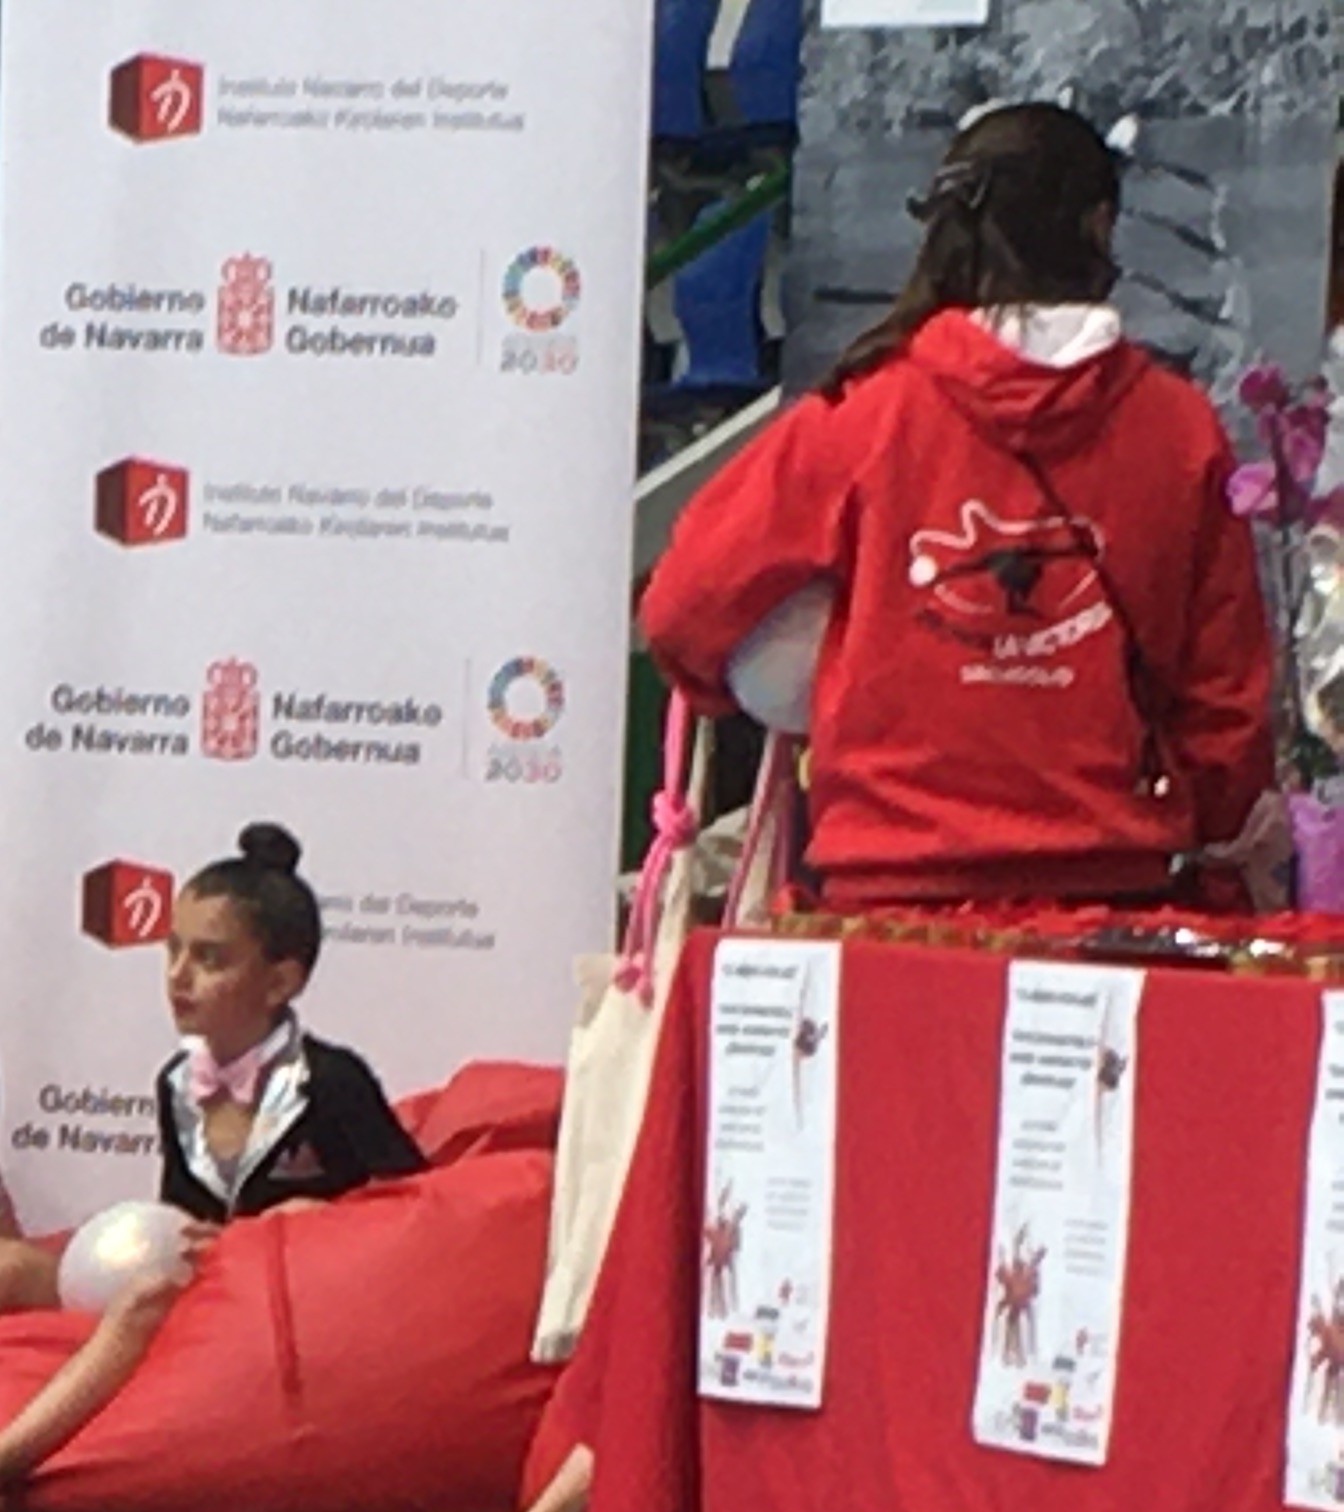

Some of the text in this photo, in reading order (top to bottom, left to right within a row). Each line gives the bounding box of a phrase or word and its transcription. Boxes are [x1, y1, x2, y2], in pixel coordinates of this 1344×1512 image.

[64, 282, 206, 312] Gobierno
[287, 285, 458, 319] Nafarroako
[39, 321, 204, 350] de Navarra
[285, 324, 436, 357] Gobernua
[50, 683, 191, 717] Gobierno
[272, 692, 443, 727] Nafarroako
[25, 722, 189, 755] de Navarra
[270, 729, 421, 766] Gobernua
[39, 1084, 157, 1117] Gobiern
[12, 1120, 158, 1155] de Navarr
